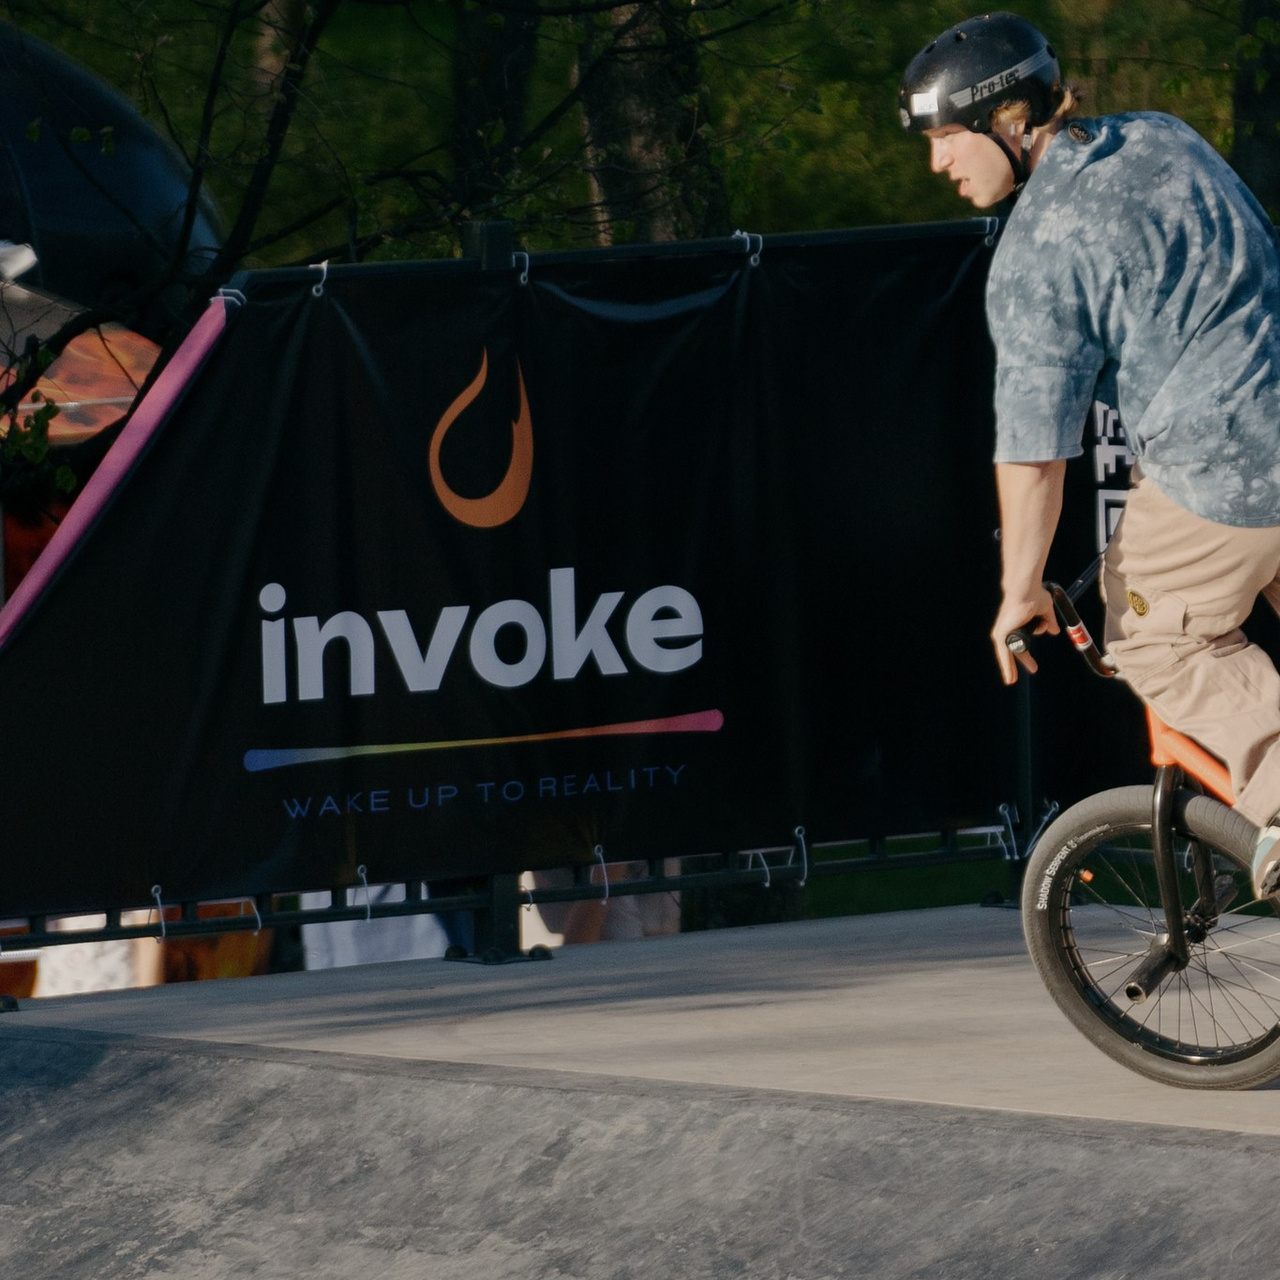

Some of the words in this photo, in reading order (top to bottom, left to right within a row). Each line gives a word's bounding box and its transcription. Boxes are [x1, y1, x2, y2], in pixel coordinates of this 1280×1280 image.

[258, 566, 704, 705] invoke
[283, 789, 391, 820] WAKE
[408, 784, 460, 809] UP
[476, 780, 525, 804] TO
[538, 764, 687, 799] REALITY
